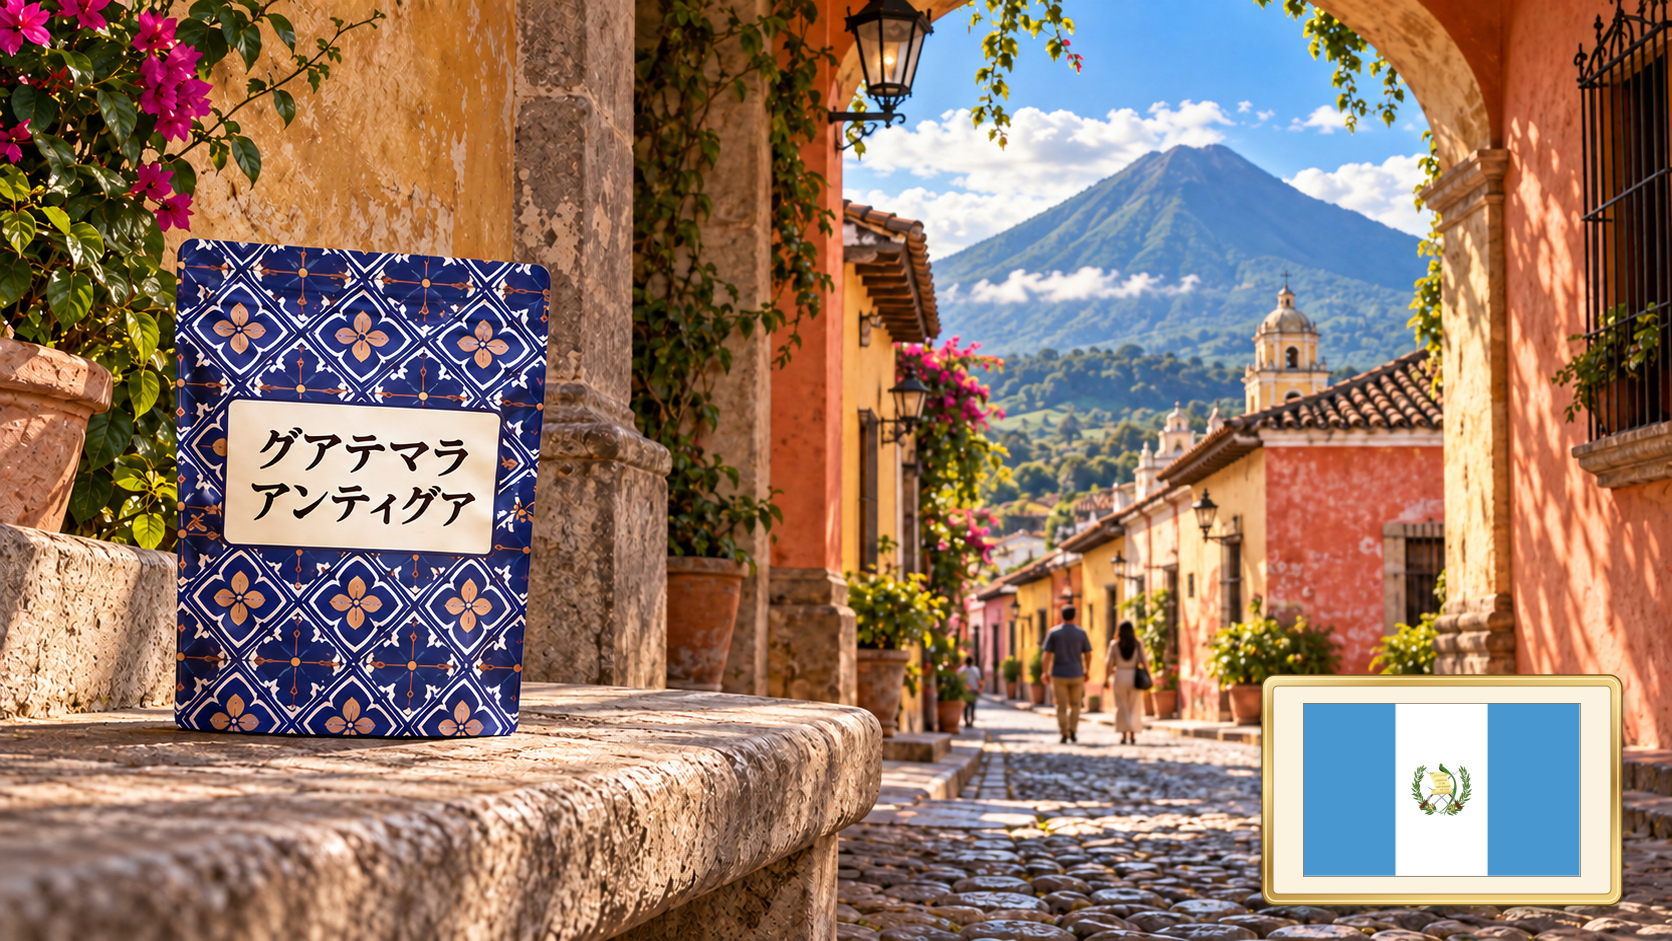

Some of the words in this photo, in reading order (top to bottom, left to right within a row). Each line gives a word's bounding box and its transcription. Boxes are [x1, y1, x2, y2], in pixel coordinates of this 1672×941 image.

[259, 427, 469, 477] グアテマラ
[251, 482, 476, 527] アンティグア
